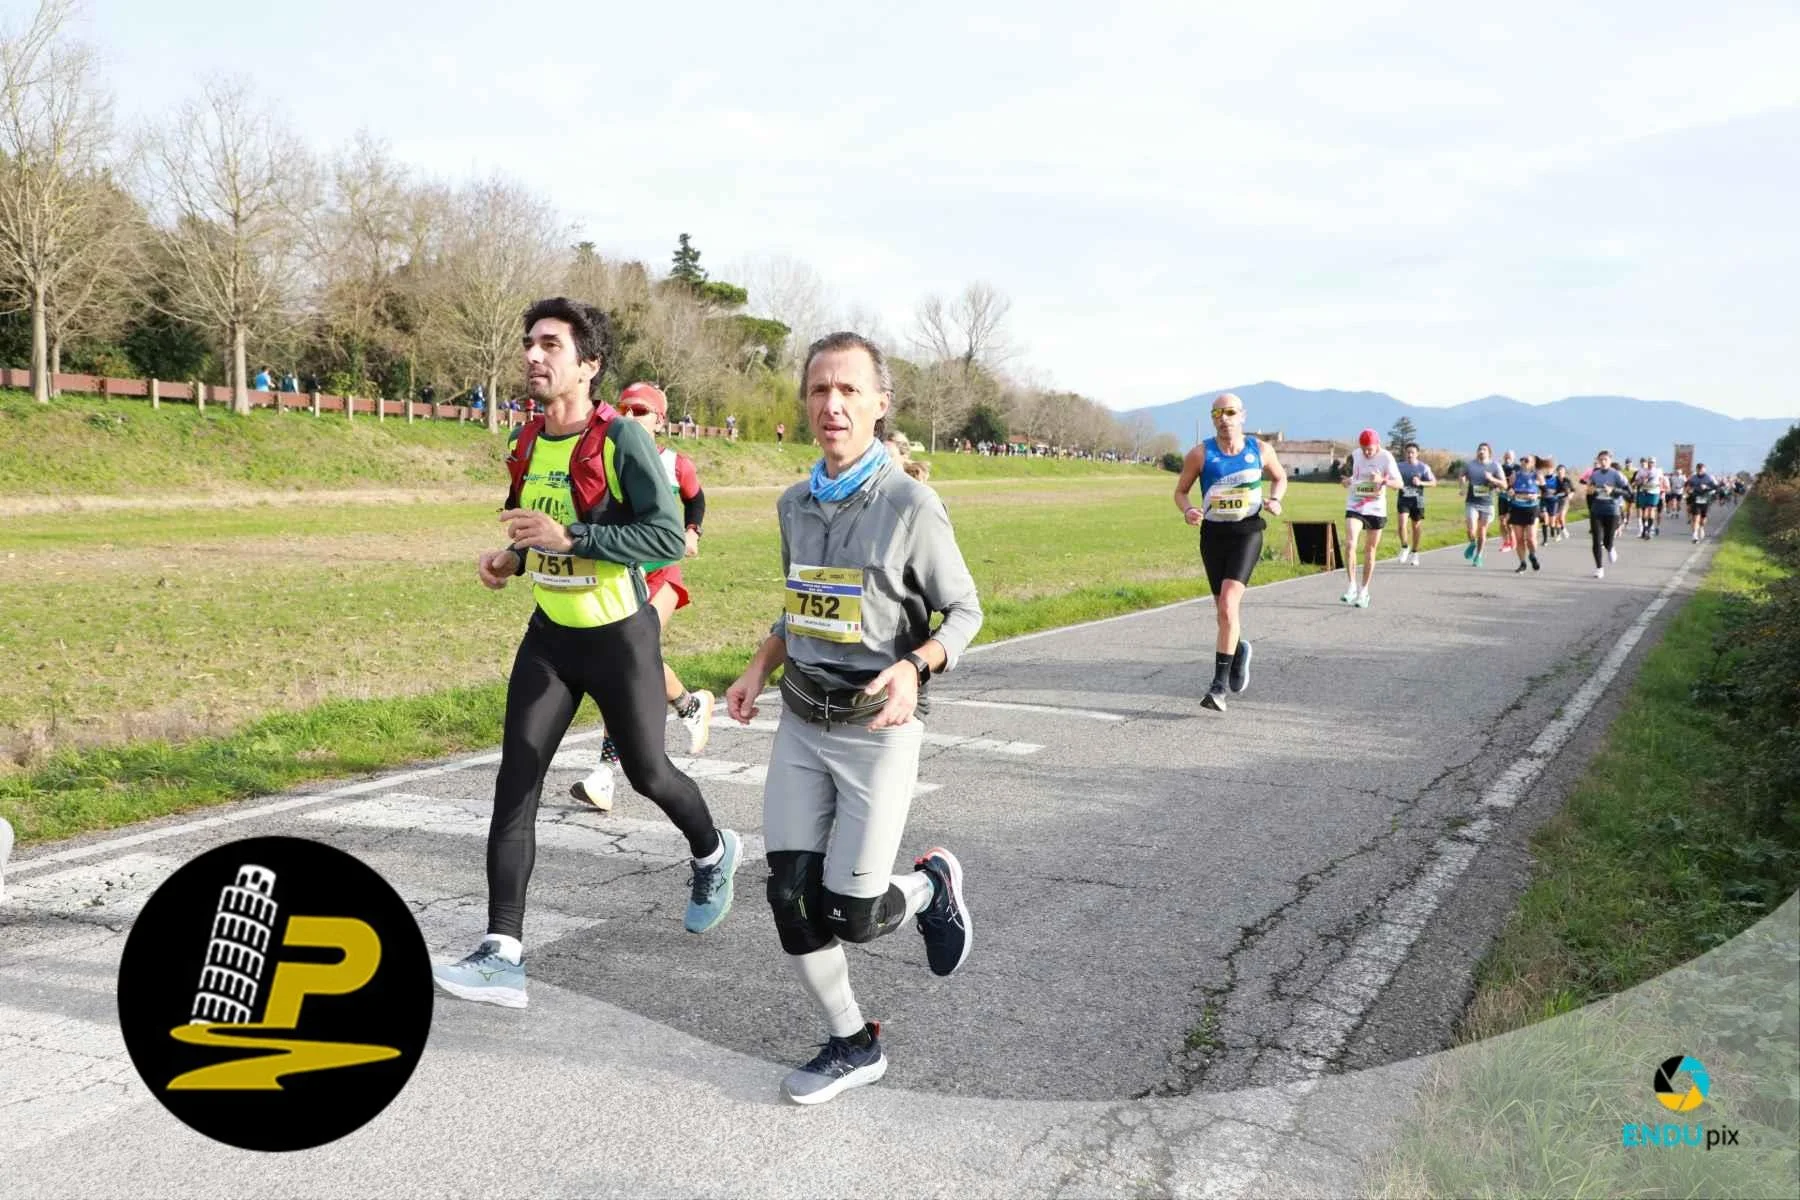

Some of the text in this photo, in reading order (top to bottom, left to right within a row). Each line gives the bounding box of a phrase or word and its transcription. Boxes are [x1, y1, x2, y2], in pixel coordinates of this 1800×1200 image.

[1219, 499, 1243, 509] 510
[537, 555, 575, 576] 751
[796, 592, 840, 620] 752
